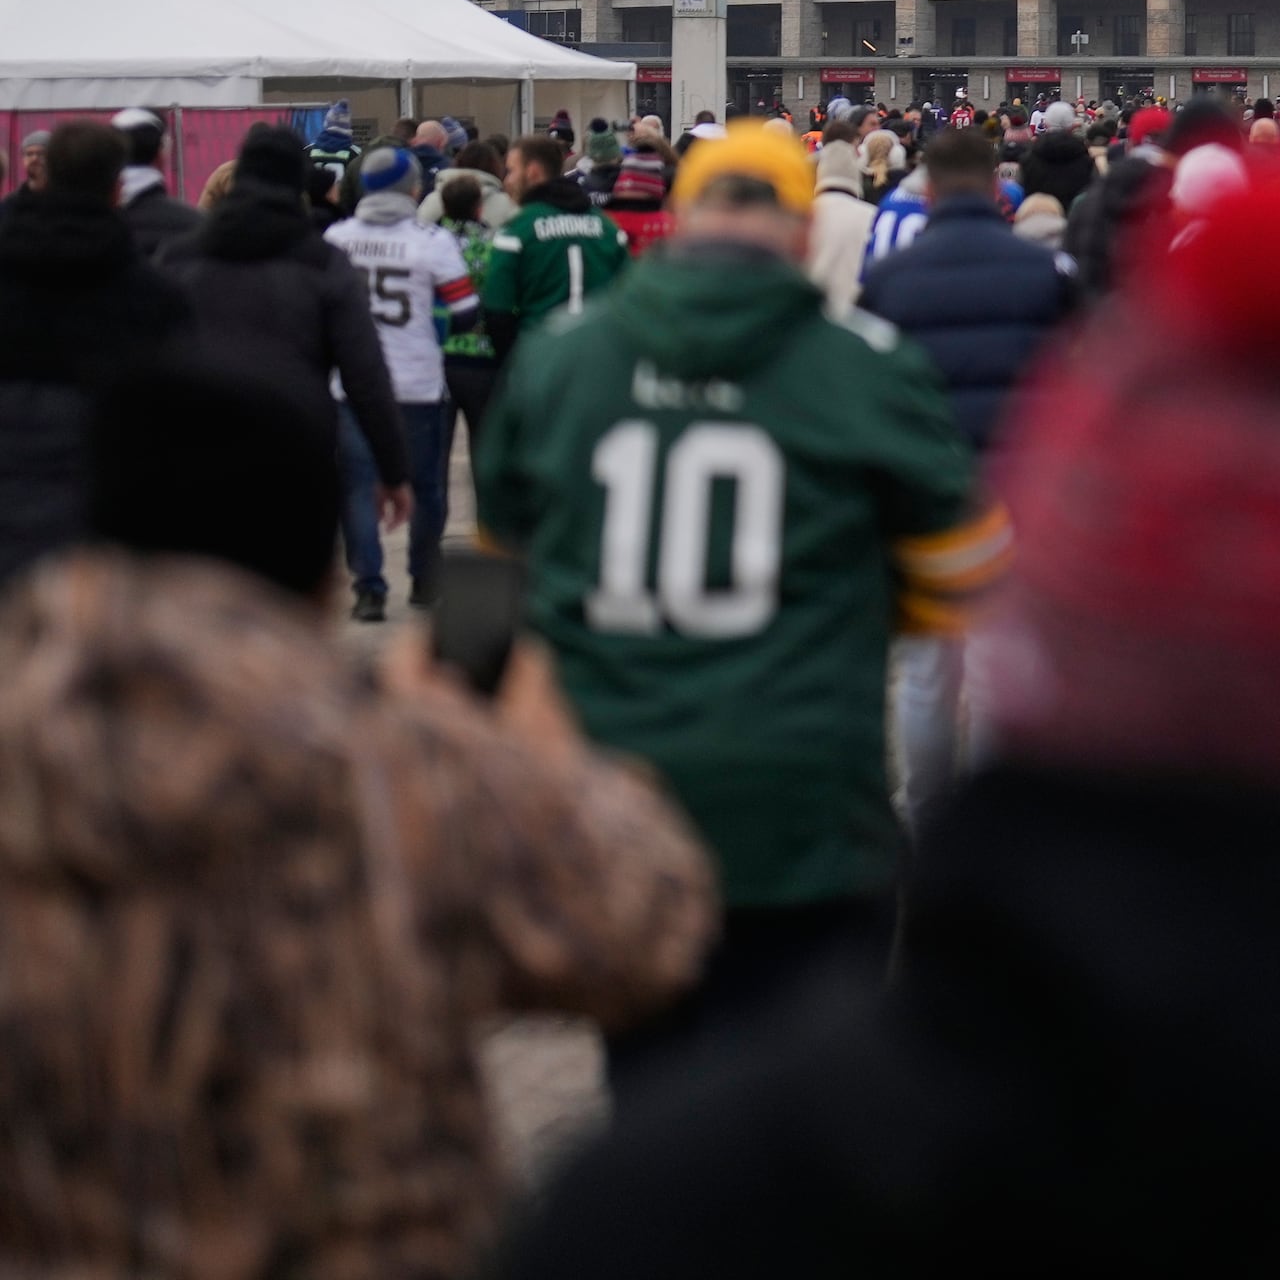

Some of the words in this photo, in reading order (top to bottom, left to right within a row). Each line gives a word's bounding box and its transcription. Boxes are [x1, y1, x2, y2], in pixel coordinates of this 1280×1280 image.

[368, 267, 412, 327] 5
[567, 244, 584, 315] 1
[582, 419, 786, 639] 10
